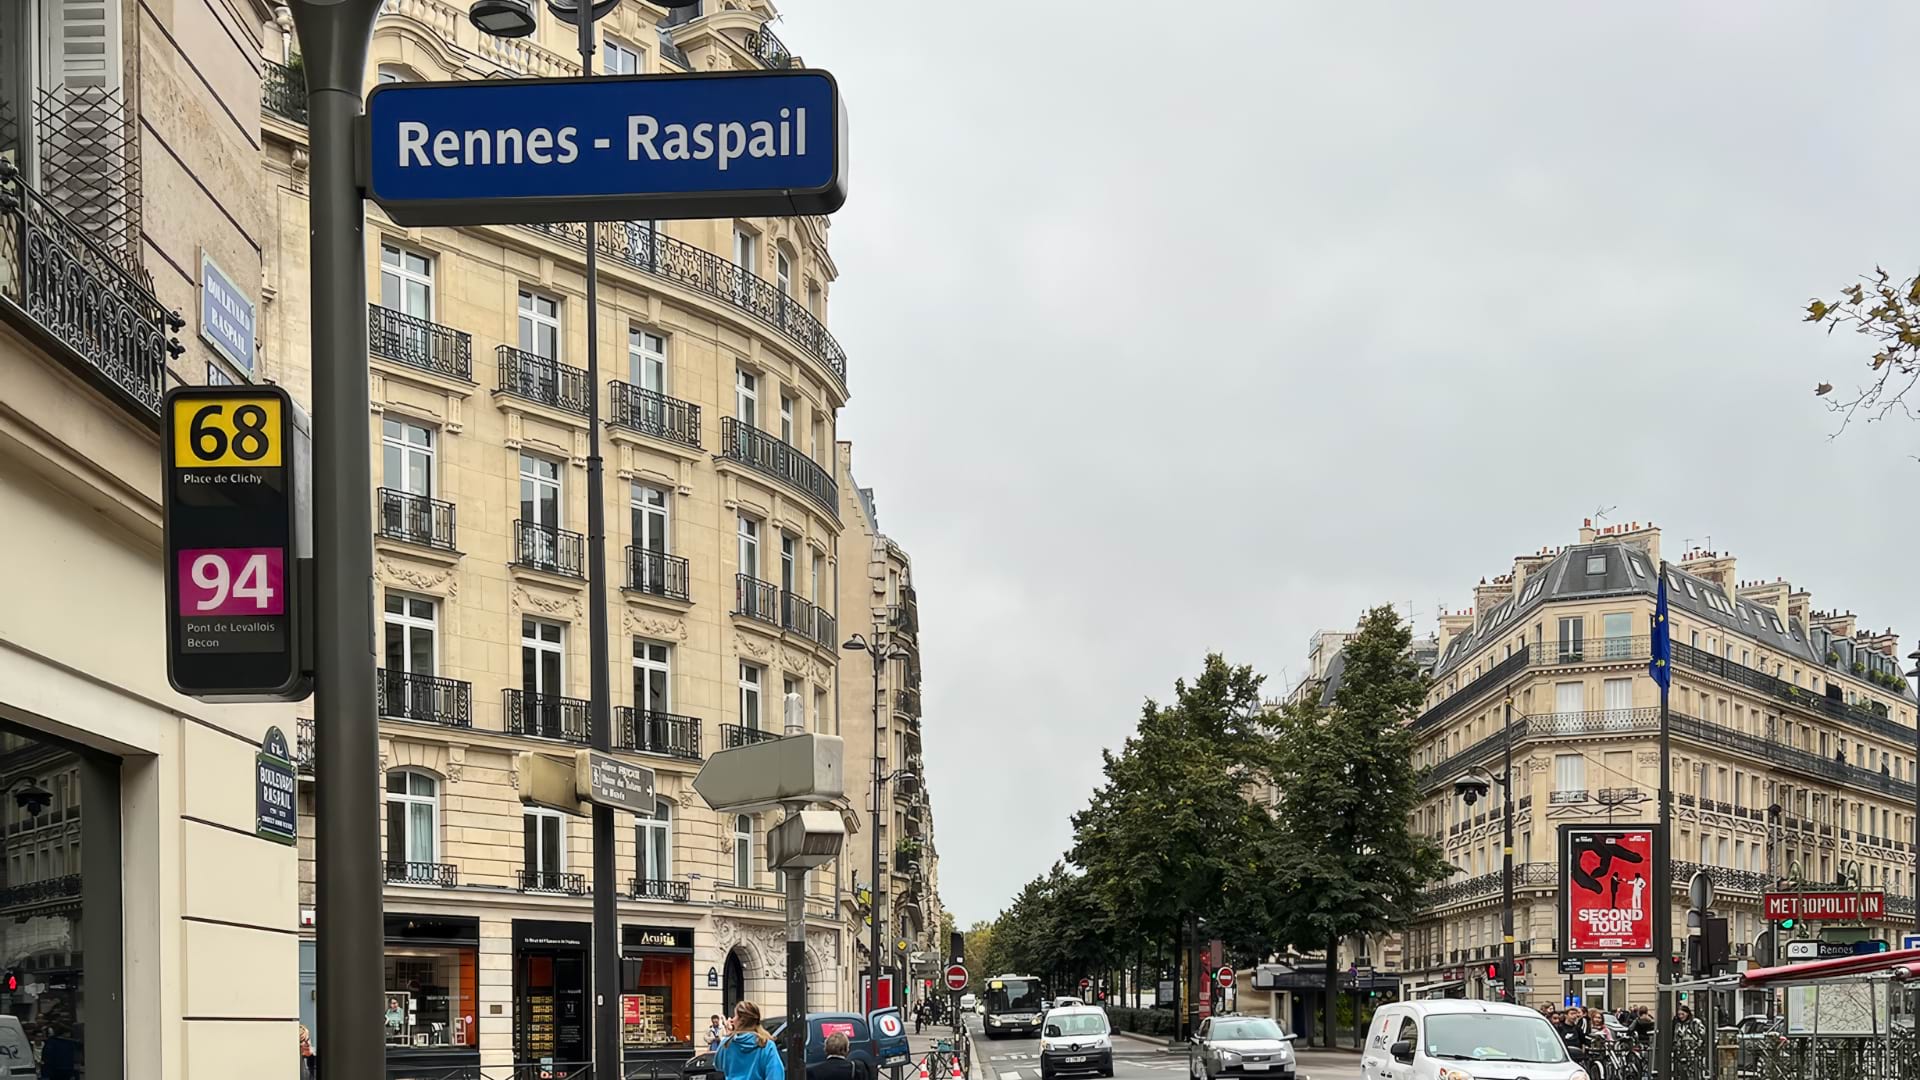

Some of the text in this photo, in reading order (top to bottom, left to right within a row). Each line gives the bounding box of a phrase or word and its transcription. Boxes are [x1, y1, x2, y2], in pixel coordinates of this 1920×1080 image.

[398, 107, 807, 171] Rennes - Raspail
[211, 306, 247, 356] RASPAIL
[189, 404, 270, 461] 68
[183, 473, 263, 485] Place de Clichy
[191, 554, 274, 611] 94
[187, 621, 276, 633] Pont de Levallois
[260, 766, 293, 792] BOULEVARD
[263, 785, 292, 809] RASPAIL
[1578, 909, 1643, 922] SECOND
[1589, 921, 1633, 932] TOUR
[1820, 945, 1854, 954] Rennes
